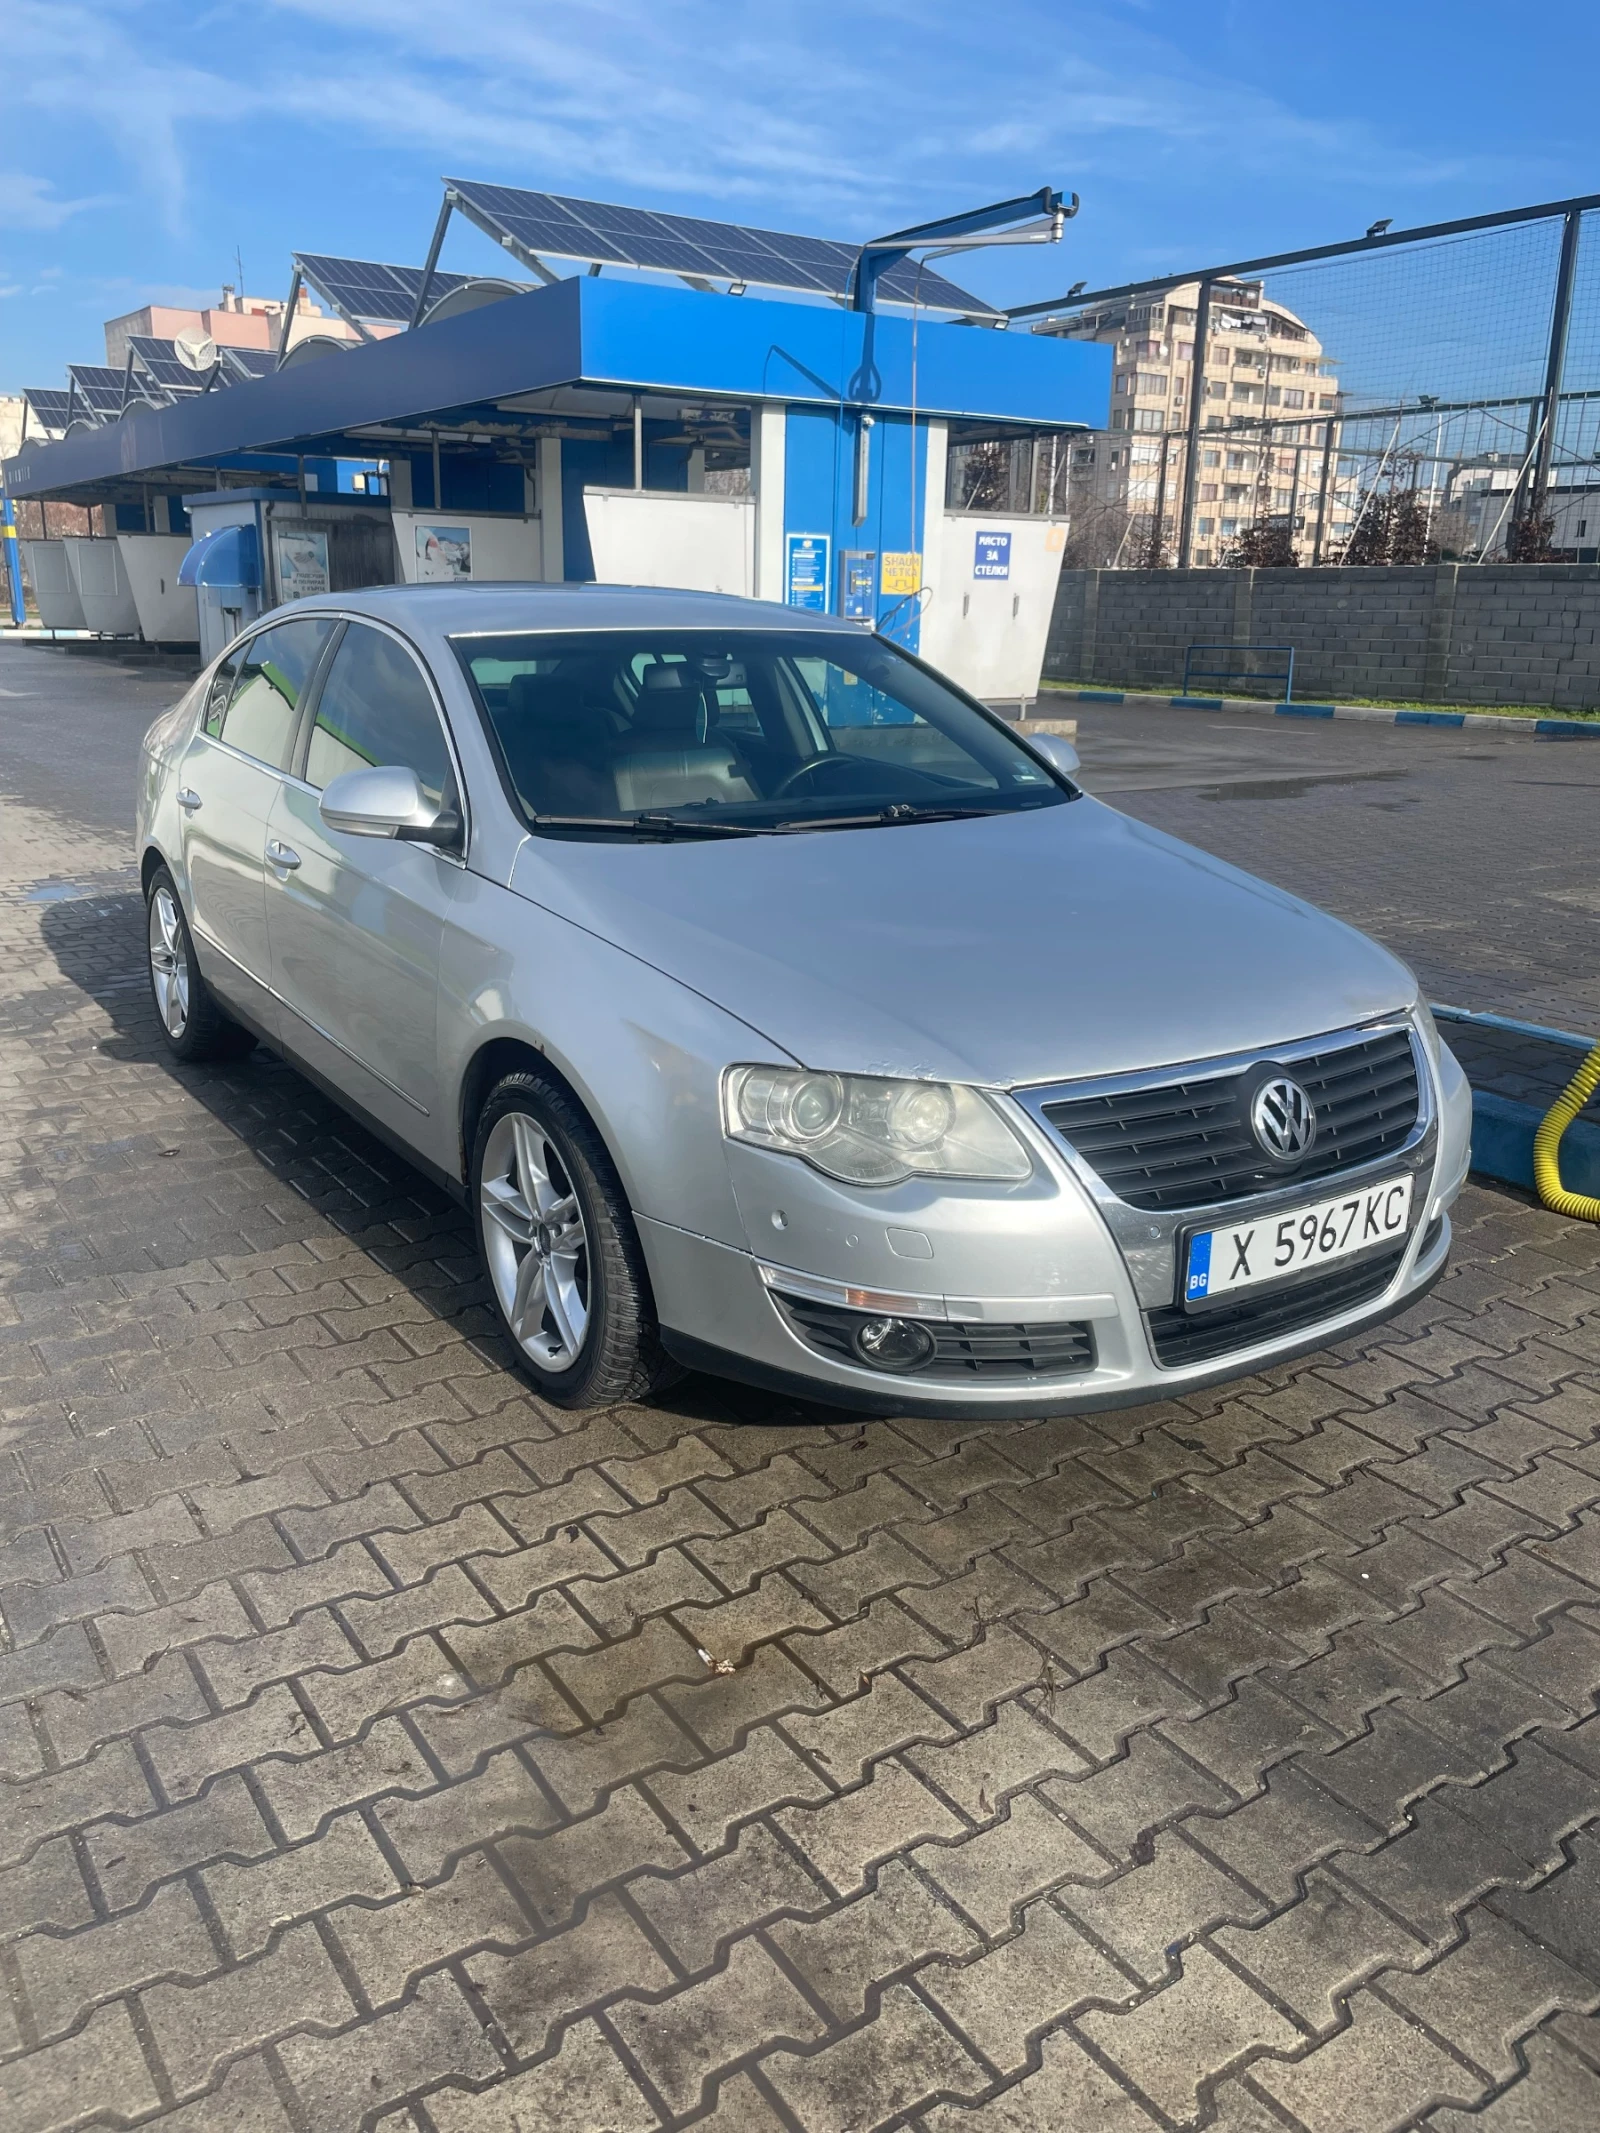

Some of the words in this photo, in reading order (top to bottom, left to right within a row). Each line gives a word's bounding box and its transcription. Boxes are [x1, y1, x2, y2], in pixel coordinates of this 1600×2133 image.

[978, 536, 1008, 546] МЯСТО
[986, 550, 999, 561] ЗА
[885, 567, 918, 577] ЧЕТКА
[974, 565, 1008, 576] СТЕЛКИ
[1190, 1272, 1208, 1290] BG
